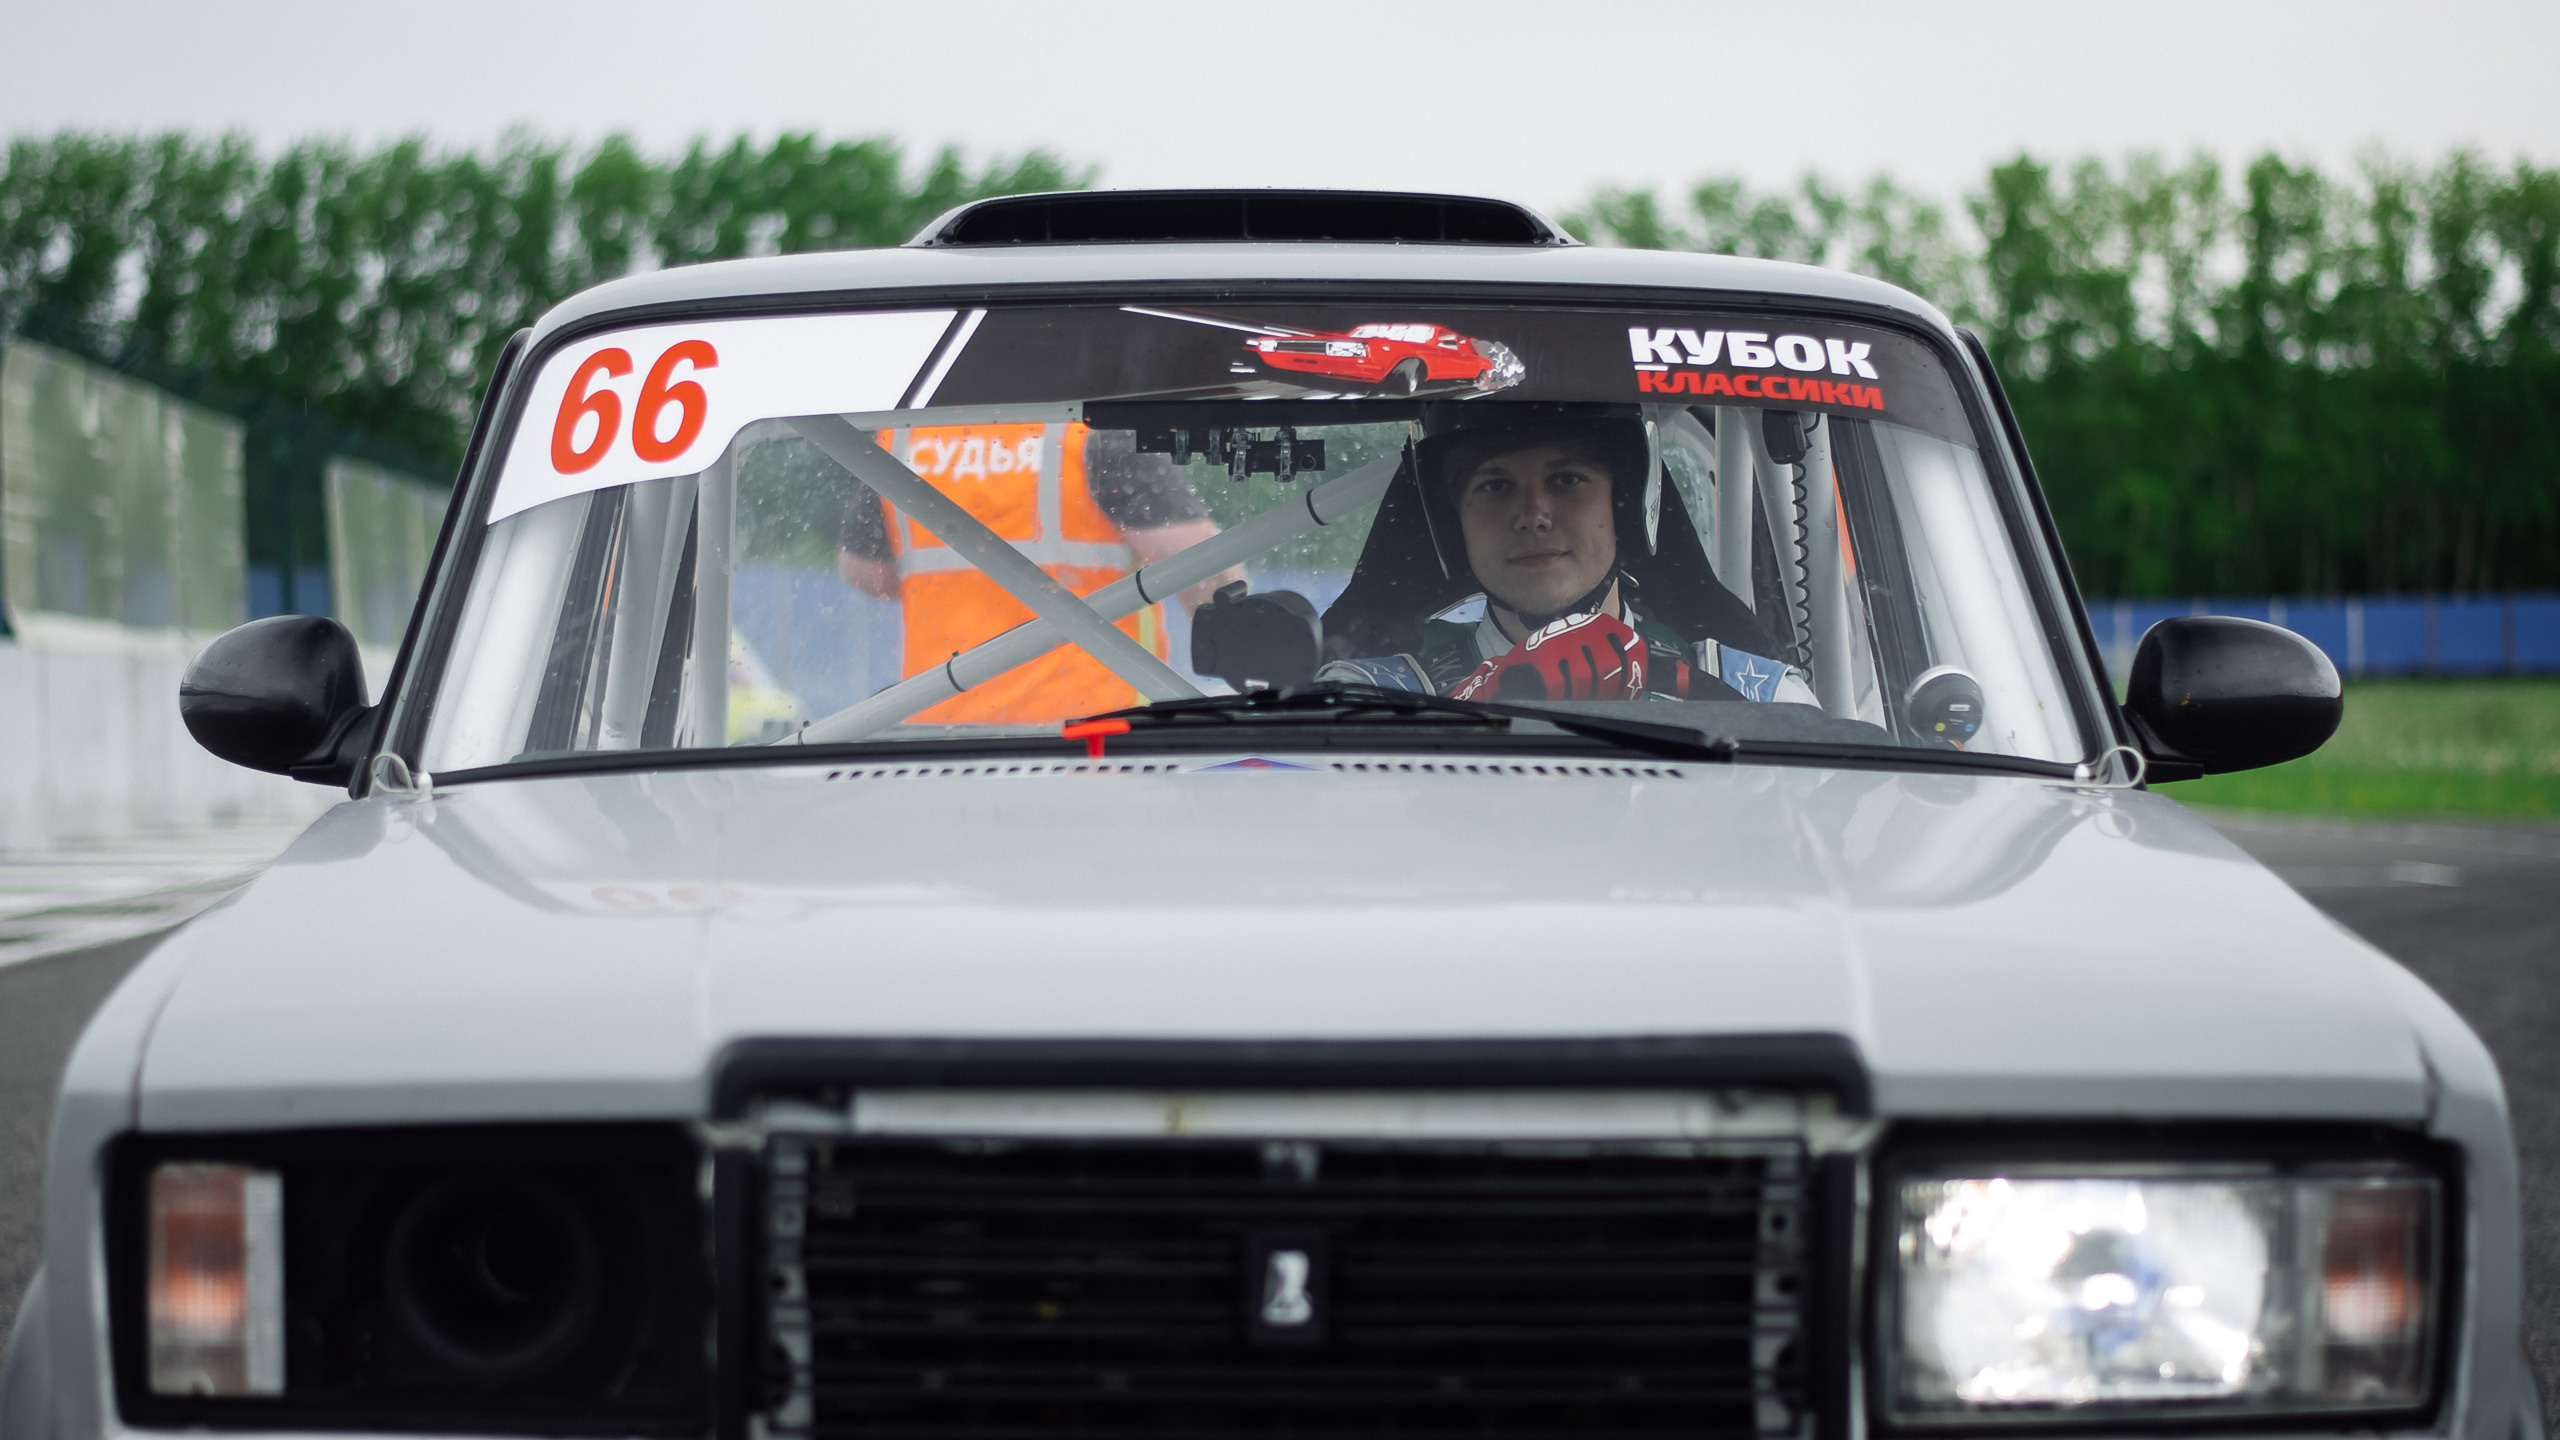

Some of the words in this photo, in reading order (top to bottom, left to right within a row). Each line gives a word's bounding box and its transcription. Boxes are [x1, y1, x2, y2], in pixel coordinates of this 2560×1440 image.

[1628, 327, 1879, 380] КУБОК
[551, 339, 719, 475] 66
[1636, 370, 1884, 411] КЛАССИКИ
[905, 436, 1044, 481] СУДЬЯ
